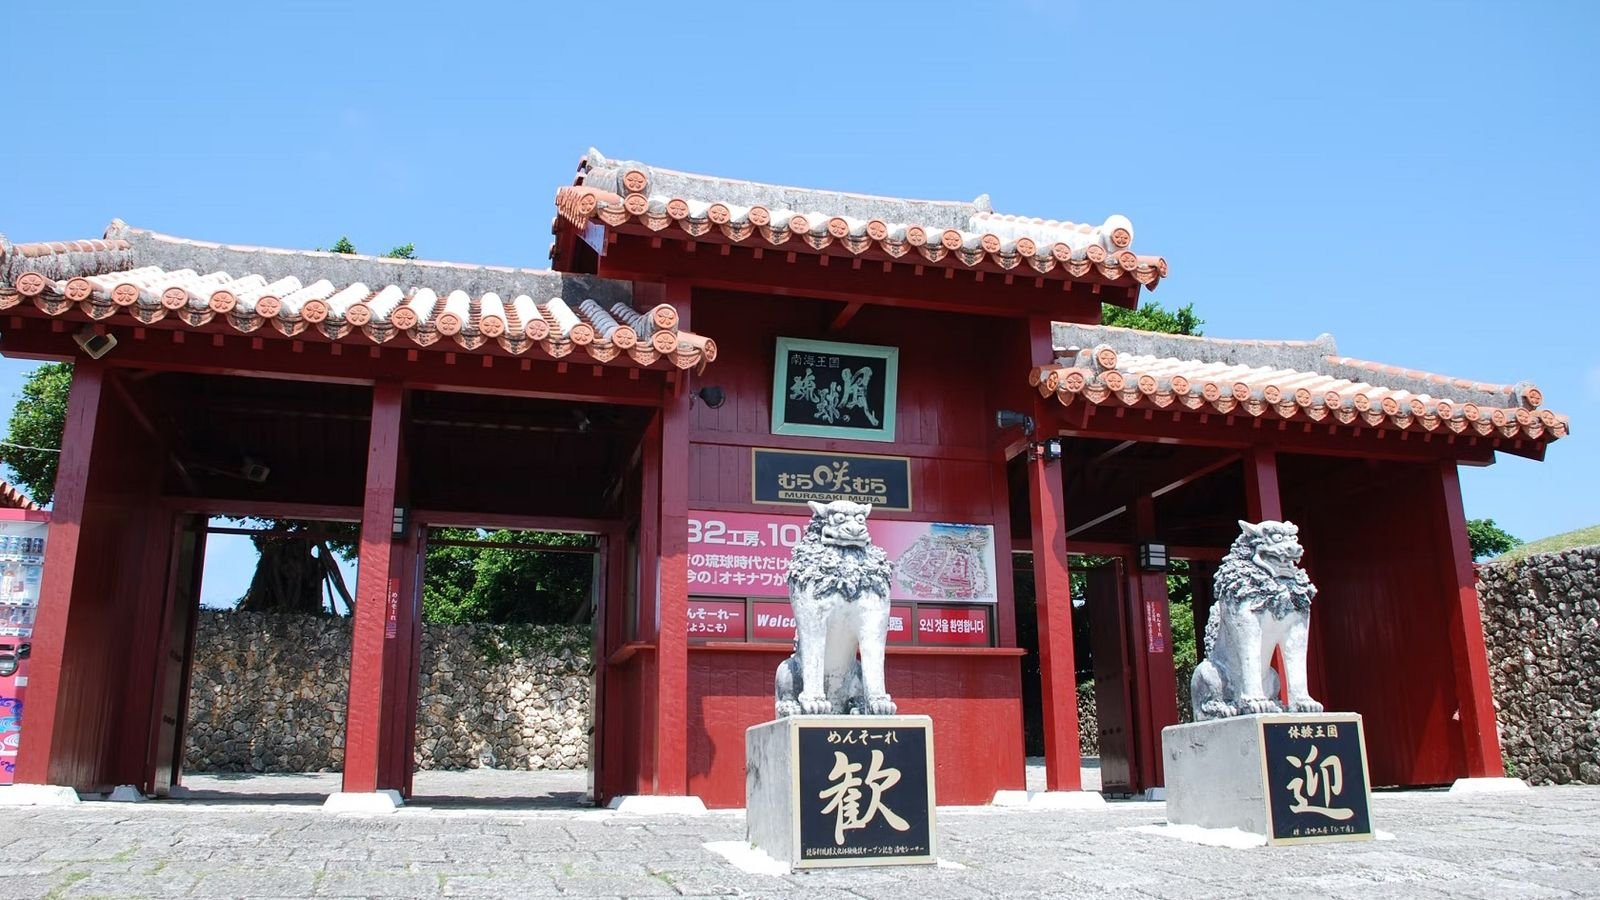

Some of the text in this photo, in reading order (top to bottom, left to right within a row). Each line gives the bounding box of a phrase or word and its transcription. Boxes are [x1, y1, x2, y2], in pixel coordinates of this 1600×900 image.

[791, 354, 840, 368] 南海王国
[784, 492, 880, 503] MURASAKI MURA
[919, 618, 934, 632] 오신
[827, 730, 899, 745] めんそーれ
[1287, 724, 1338, 739] 体験王国
[1286, 745, 1354, 820] 迎
[819, 750, 911, 845] 歓
